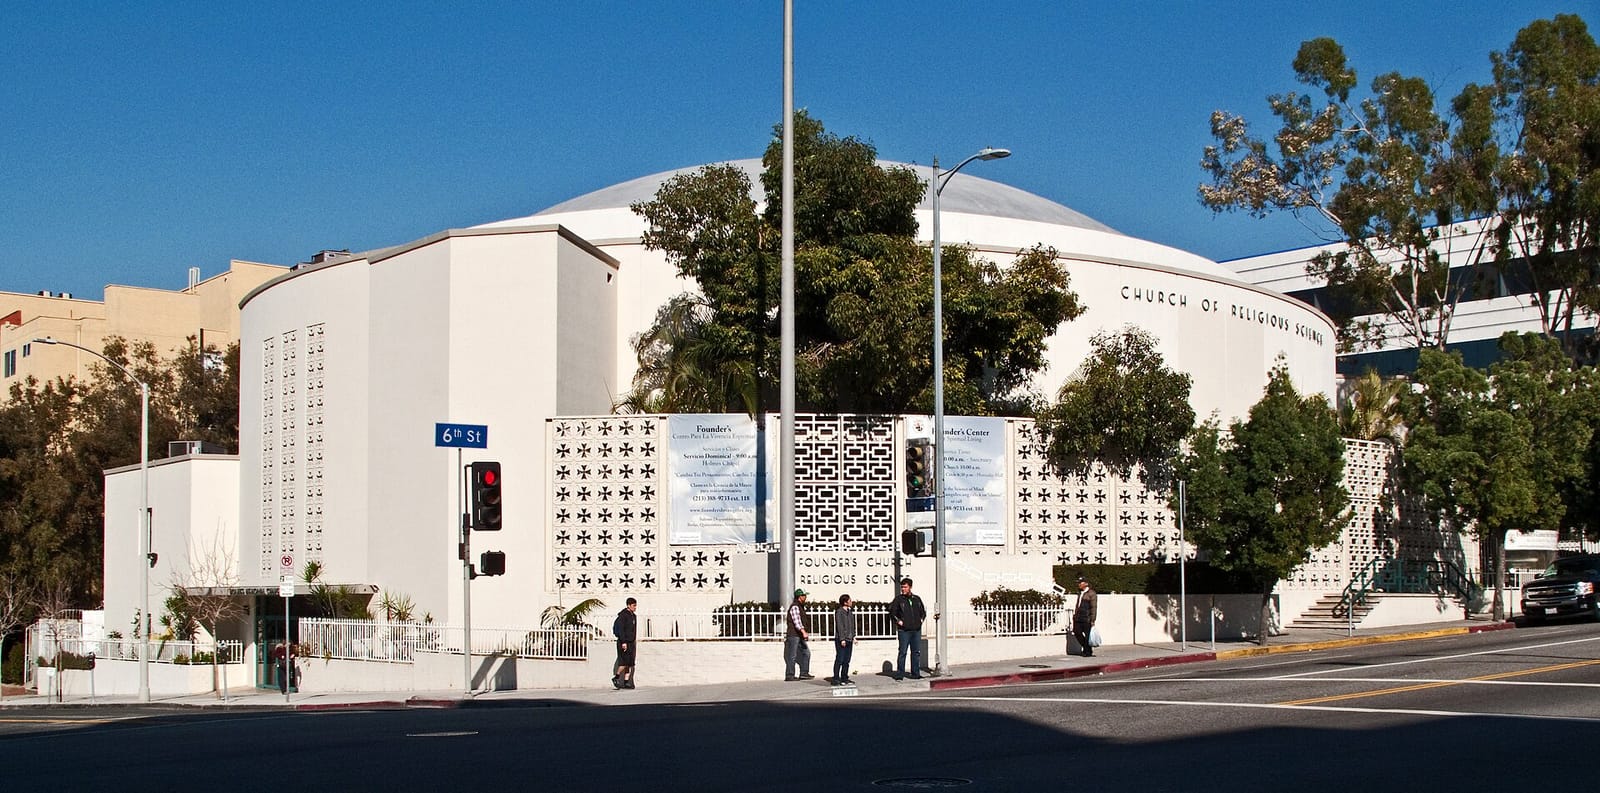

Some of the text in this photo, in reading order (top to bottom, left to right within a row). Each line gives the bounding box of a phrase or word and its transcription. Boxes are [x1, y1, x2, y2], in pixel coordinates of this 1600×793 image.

[1120, 286, 1324, 347] CHURCH OF RELIGIOUS SCIENCE
[697, 425, 732, 433] Founder's
[966, 427, 990, 436] Center
[443, 428, 481, 443] 6th St
[799, 557, 912, 567] FOUNDER'S CHURCH
[800, 574, 911, 585] RELIGIOUS SCIEN
